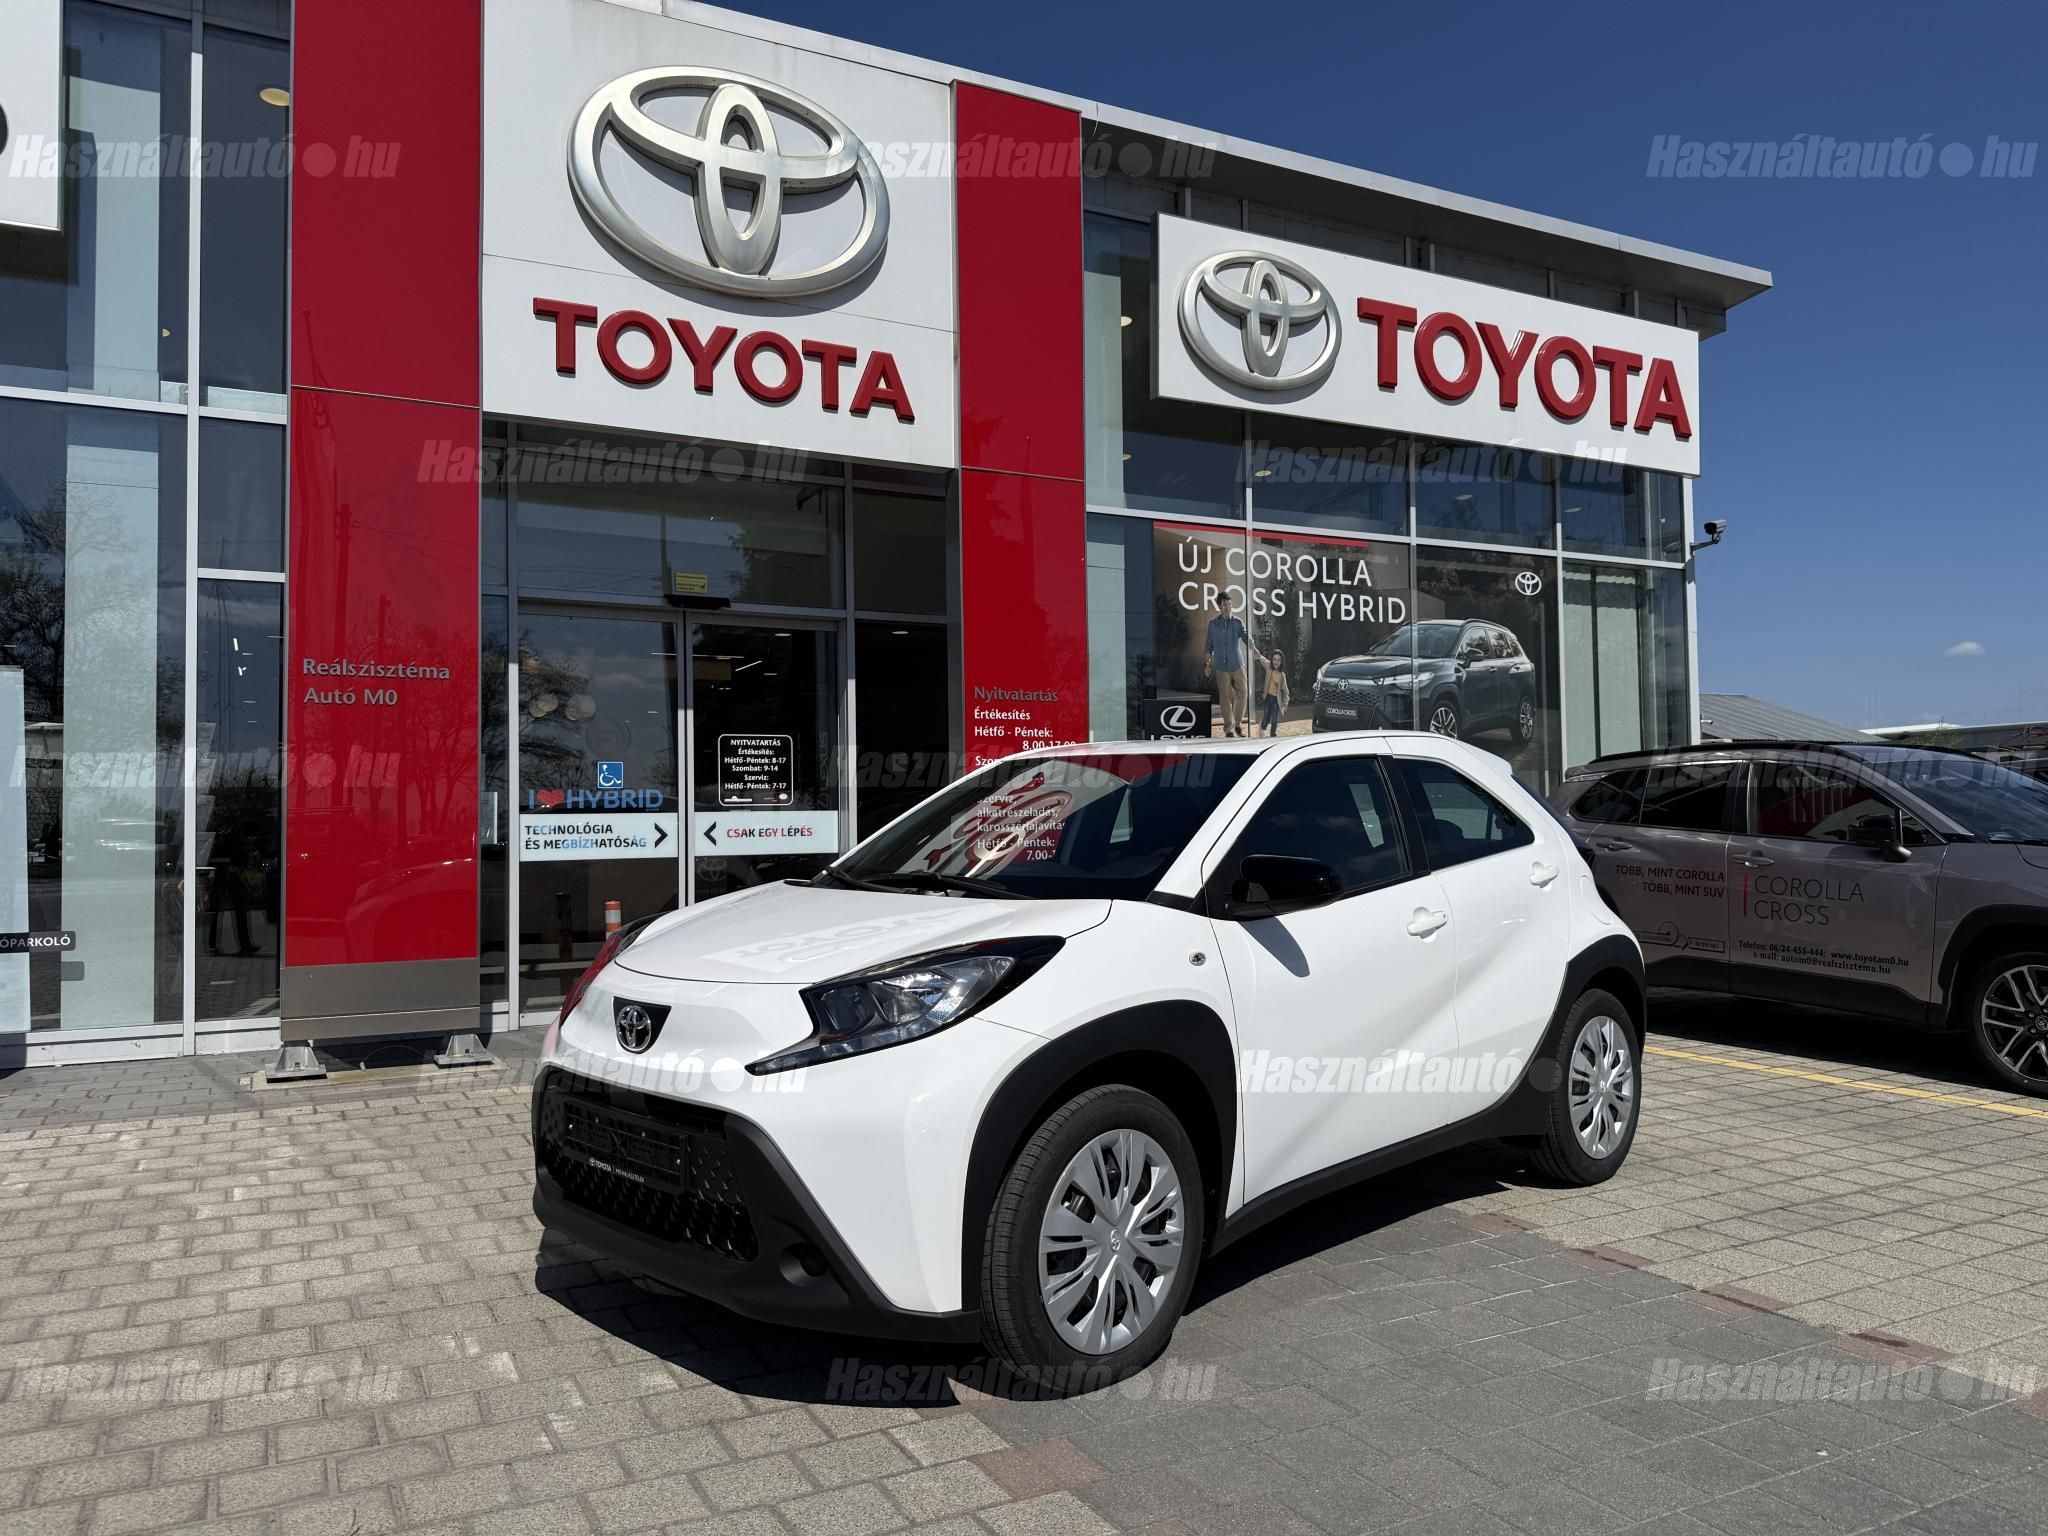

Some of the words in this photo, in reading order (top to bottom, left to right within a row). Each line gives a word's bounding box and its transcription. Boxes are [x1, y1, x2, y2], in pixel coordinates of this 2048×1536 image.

[534, 298, 915, 421] TOYOTA
[1358, 297, 1692, 437] TOYOTA
[1178, 536, 1212, 574] ÚJ
[1225, 547, 1372, 587] COROLLA
[1178, 581, 1286, 617] CROSS
[1299, 590, 1406, 624] HYBRID
[303, 658, 450, 680] Reálszisztéma
[304, 686, 356, 705] Autó
[364, 688, 398, 706] M0
[974, 686, 1058, 704] Nyitvatartás
[974, 706, 1031, 720] Értékesítés
[974, 725, 1005, 737] Hétfő
[1015, 726, 1053, 738] Péntek:
[730, 738, 781, 747] NYITVATARTÁS
[566, 788, 664, 809] HYBRID
[525, 822, 613, 835] TECHNOLÓGIA
[727, 827, 756, 838] CSAK
[759, 827, 778, 838] EGY
[781, 825, 813, 837] LÉPÉS
[525, 837, 540, 850] ÉS
[544, 835, 647, 850] MEGBÍZHATÓSÁG
[1648, 866, 1674, 878] MINT
[1676, 869, 1725, 882] COROLLA
[1675, 884, 1700, 897] MINT
[1703, 887, 1725, 898] SUV
[1754, 875, 1864, 903] COROLLA
[1754, 900, 1829, 925] CROSS
[1739, 940, 1768, 951] Telefon:
